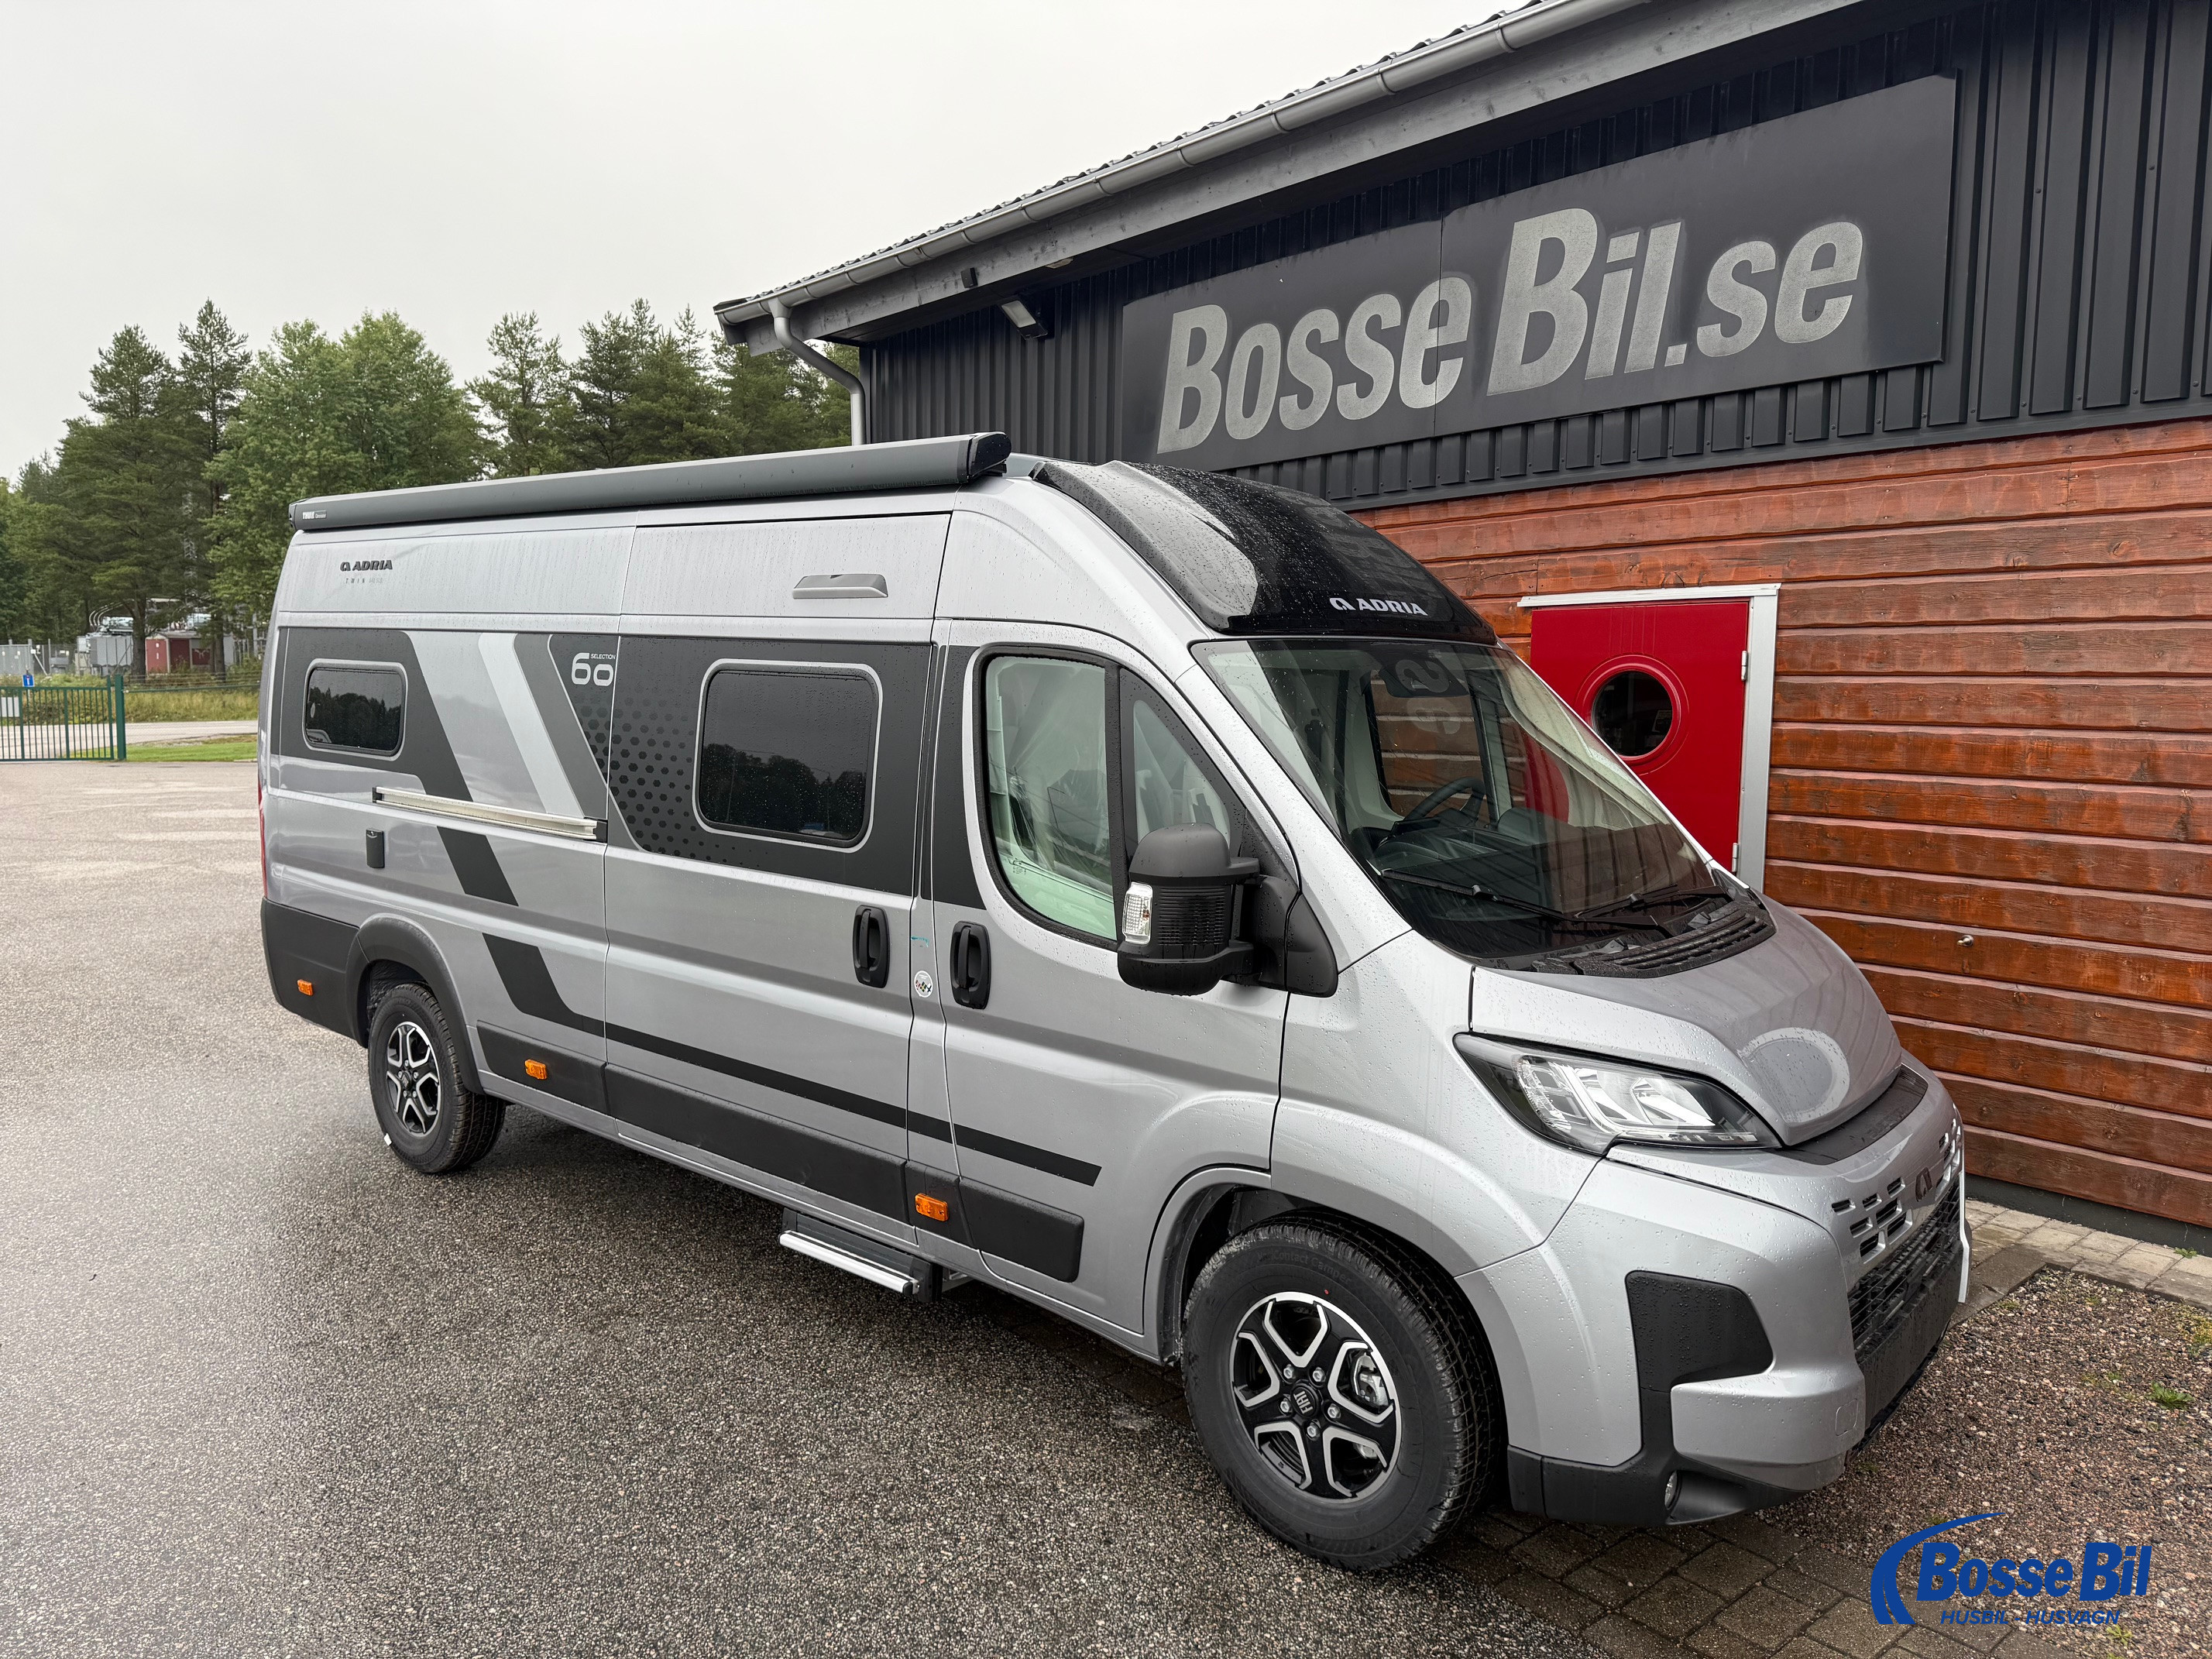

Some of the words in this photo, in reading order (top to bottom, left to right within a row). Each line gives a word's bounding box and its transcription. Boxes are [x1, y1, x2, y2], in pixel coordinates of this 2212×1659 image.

[1156, 276, 1472, 455] Bosse
[1486, 207, 1864, 397] Bil.se
[352, 559, 393, 571] ADRIA
[1355, 598, 1429, 617] ADRIA
[571, 652, 614, 687] 60
[1293, 1390, 1314, 1414] FIAT
